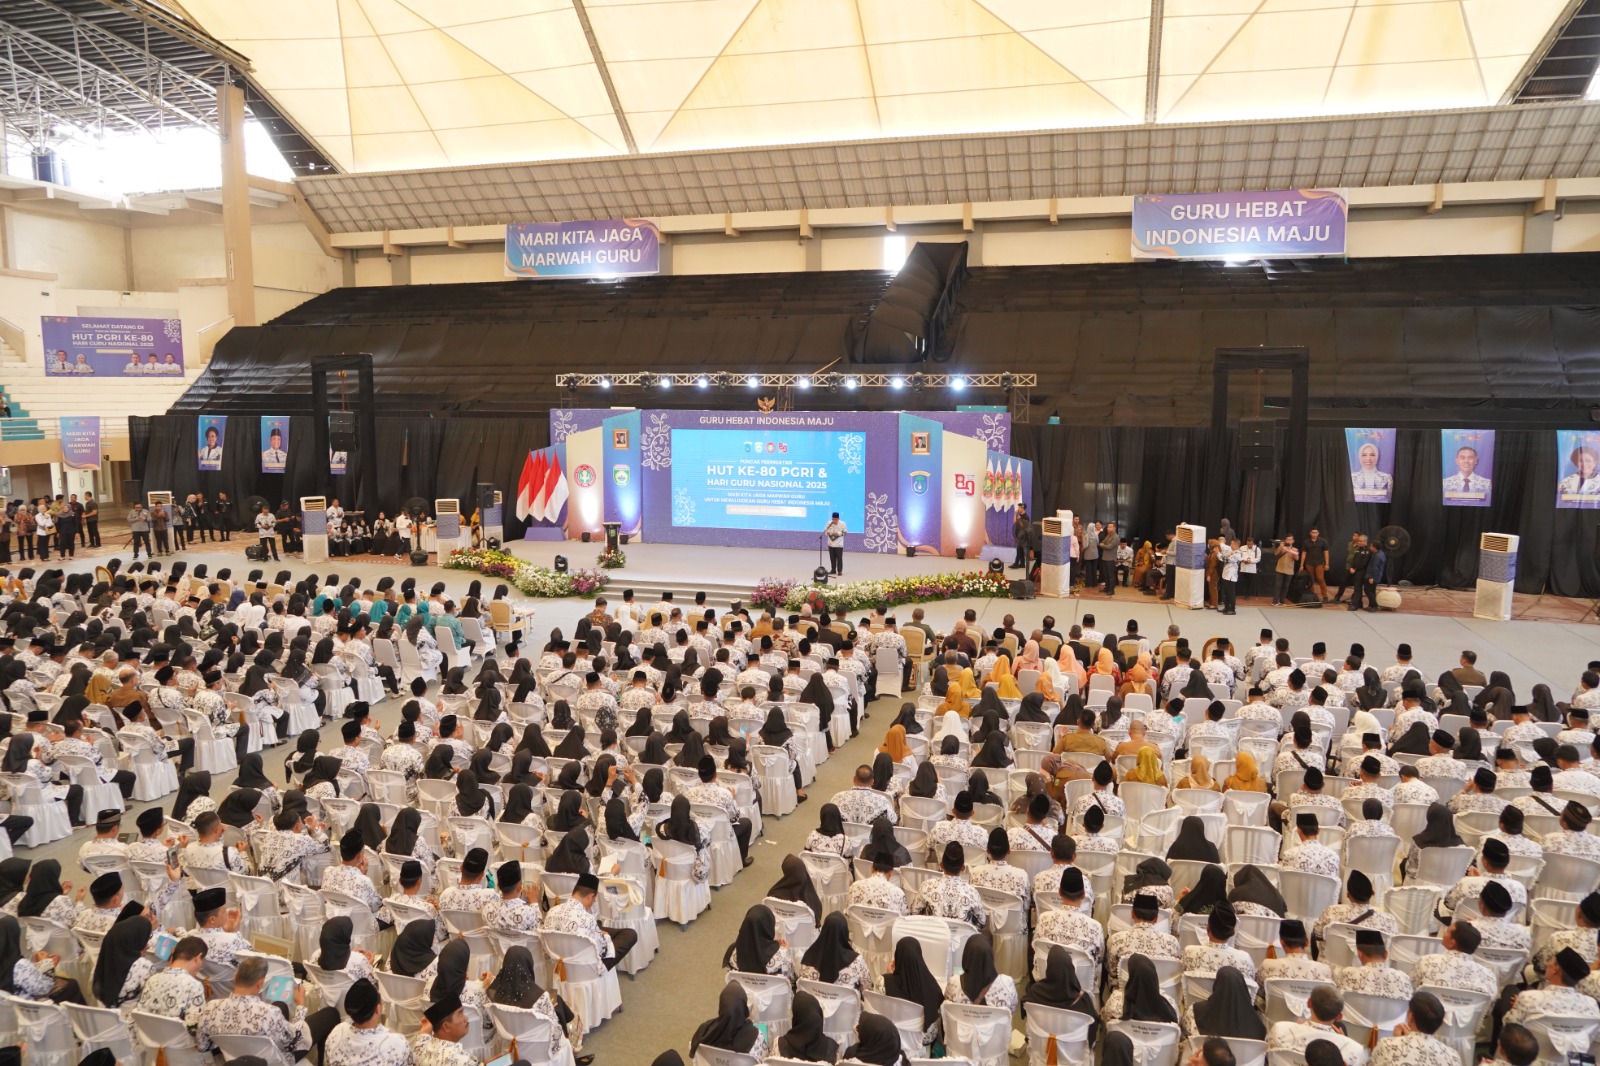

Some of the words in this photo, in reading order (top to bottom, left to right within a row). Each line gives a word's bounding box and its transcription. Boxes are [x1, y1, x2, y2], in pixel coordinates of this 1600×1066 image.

[1170, 203, 1229, 220] GURU
[1236, 201, 1307, 218] HEBAT
[519, 231, 558, 246] MARI
[562, 230, 595, 244] KITA
[600, 228, 643, 242] JAGA
[1146, 226, 1261, 245] INDONESIA
[1267, 225, 1330, 242] MAJU
[522, 251, 592, 266] MARWAH
[595, 249, 641, 263] GURU
[699, 416, 724, 424] GURU
[726, 417, 754, 425] HEBAT
[756, 417, 806, 425] INDONESIA
[807, 418, 834, 426] MAJU
[707, 465, 734, 475] HUT
[738, 465, 777, 477] KE-80
[781, 466, 814, 478] PGRI
[818, 467, 828, 478] &
[707, 478, 729, 486] HARI
[730, 479, 756, 487] GURU
[757, 480, 804, 488] NASIONAL
[806, 481, 827, 489] 2025
